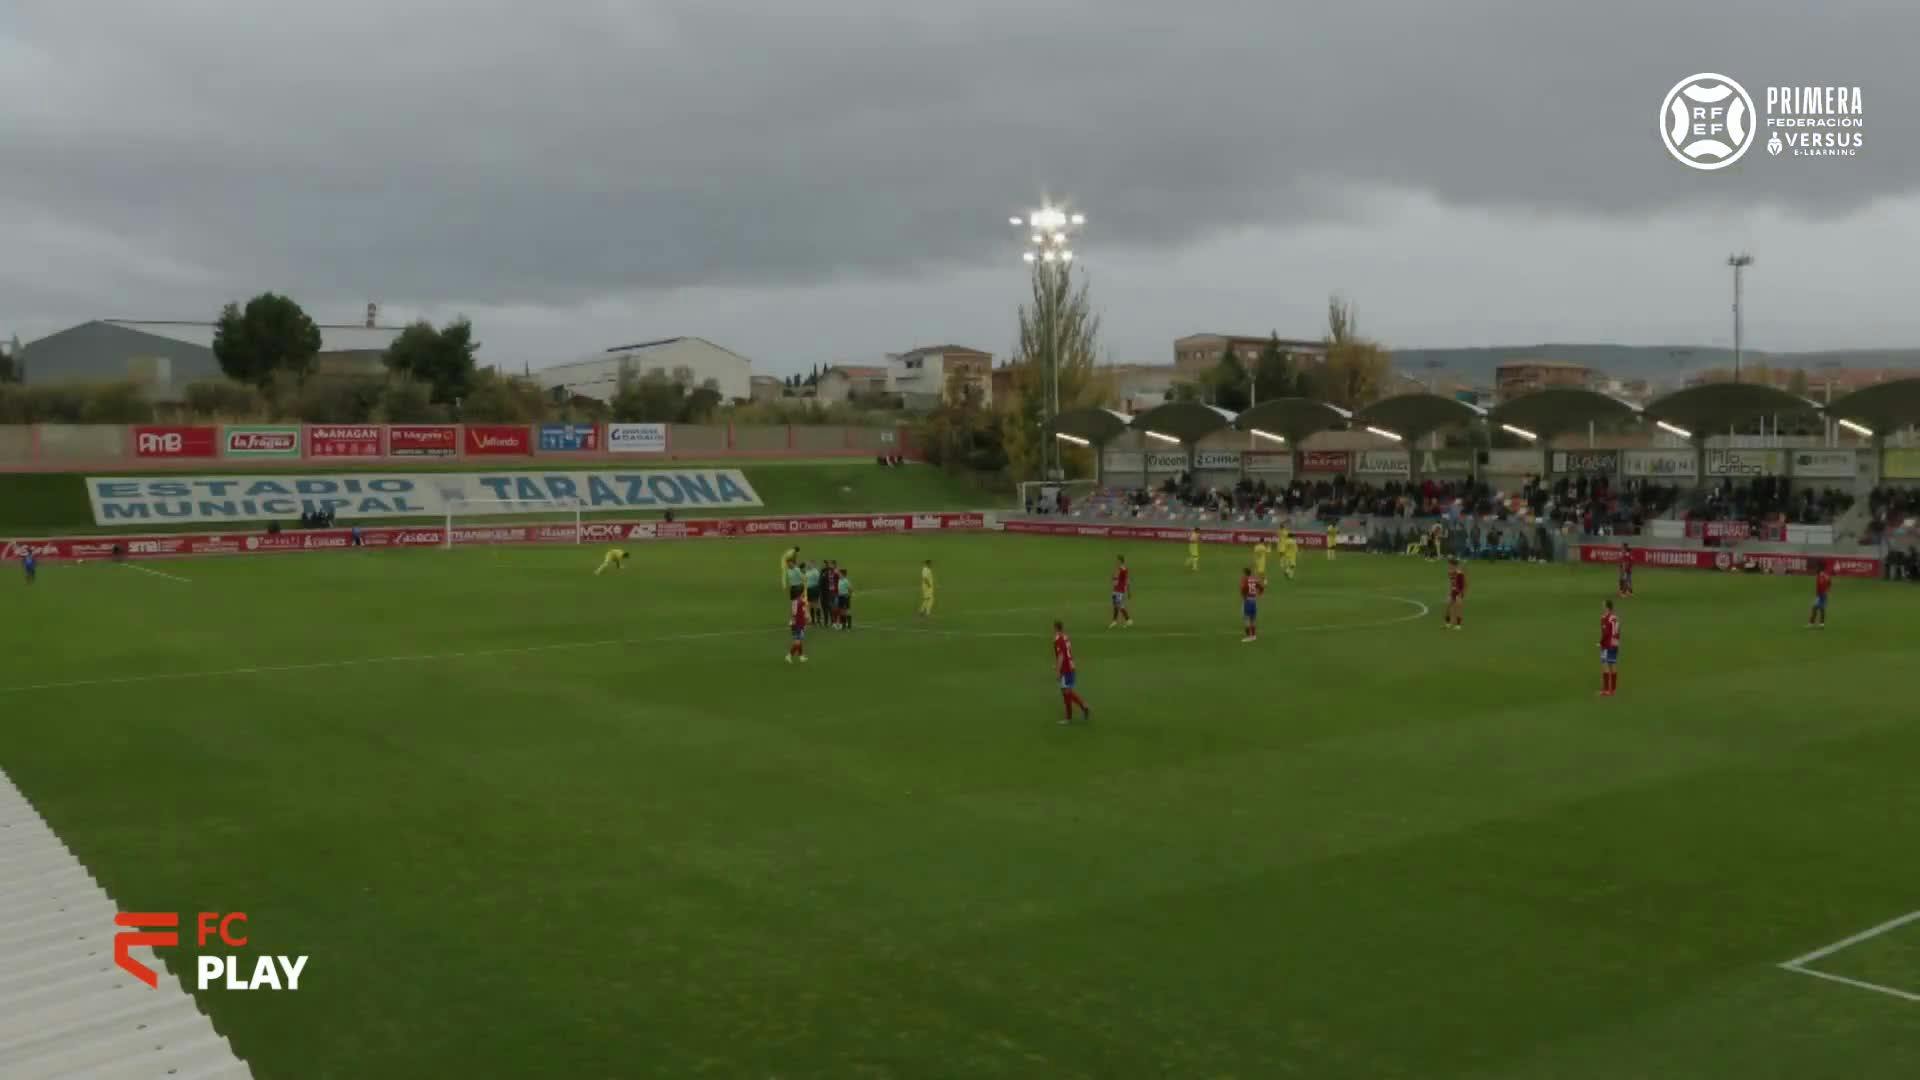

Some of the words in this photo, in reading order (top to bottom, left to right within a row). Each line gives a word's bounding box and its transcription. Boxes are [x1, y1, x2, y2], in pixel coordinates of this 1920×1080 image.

[97, 479, 415, 498] ESTADIO
[480, 474, 753, 505] TARAZONA
[101, 496, 424, 519] MUNICIPAL
